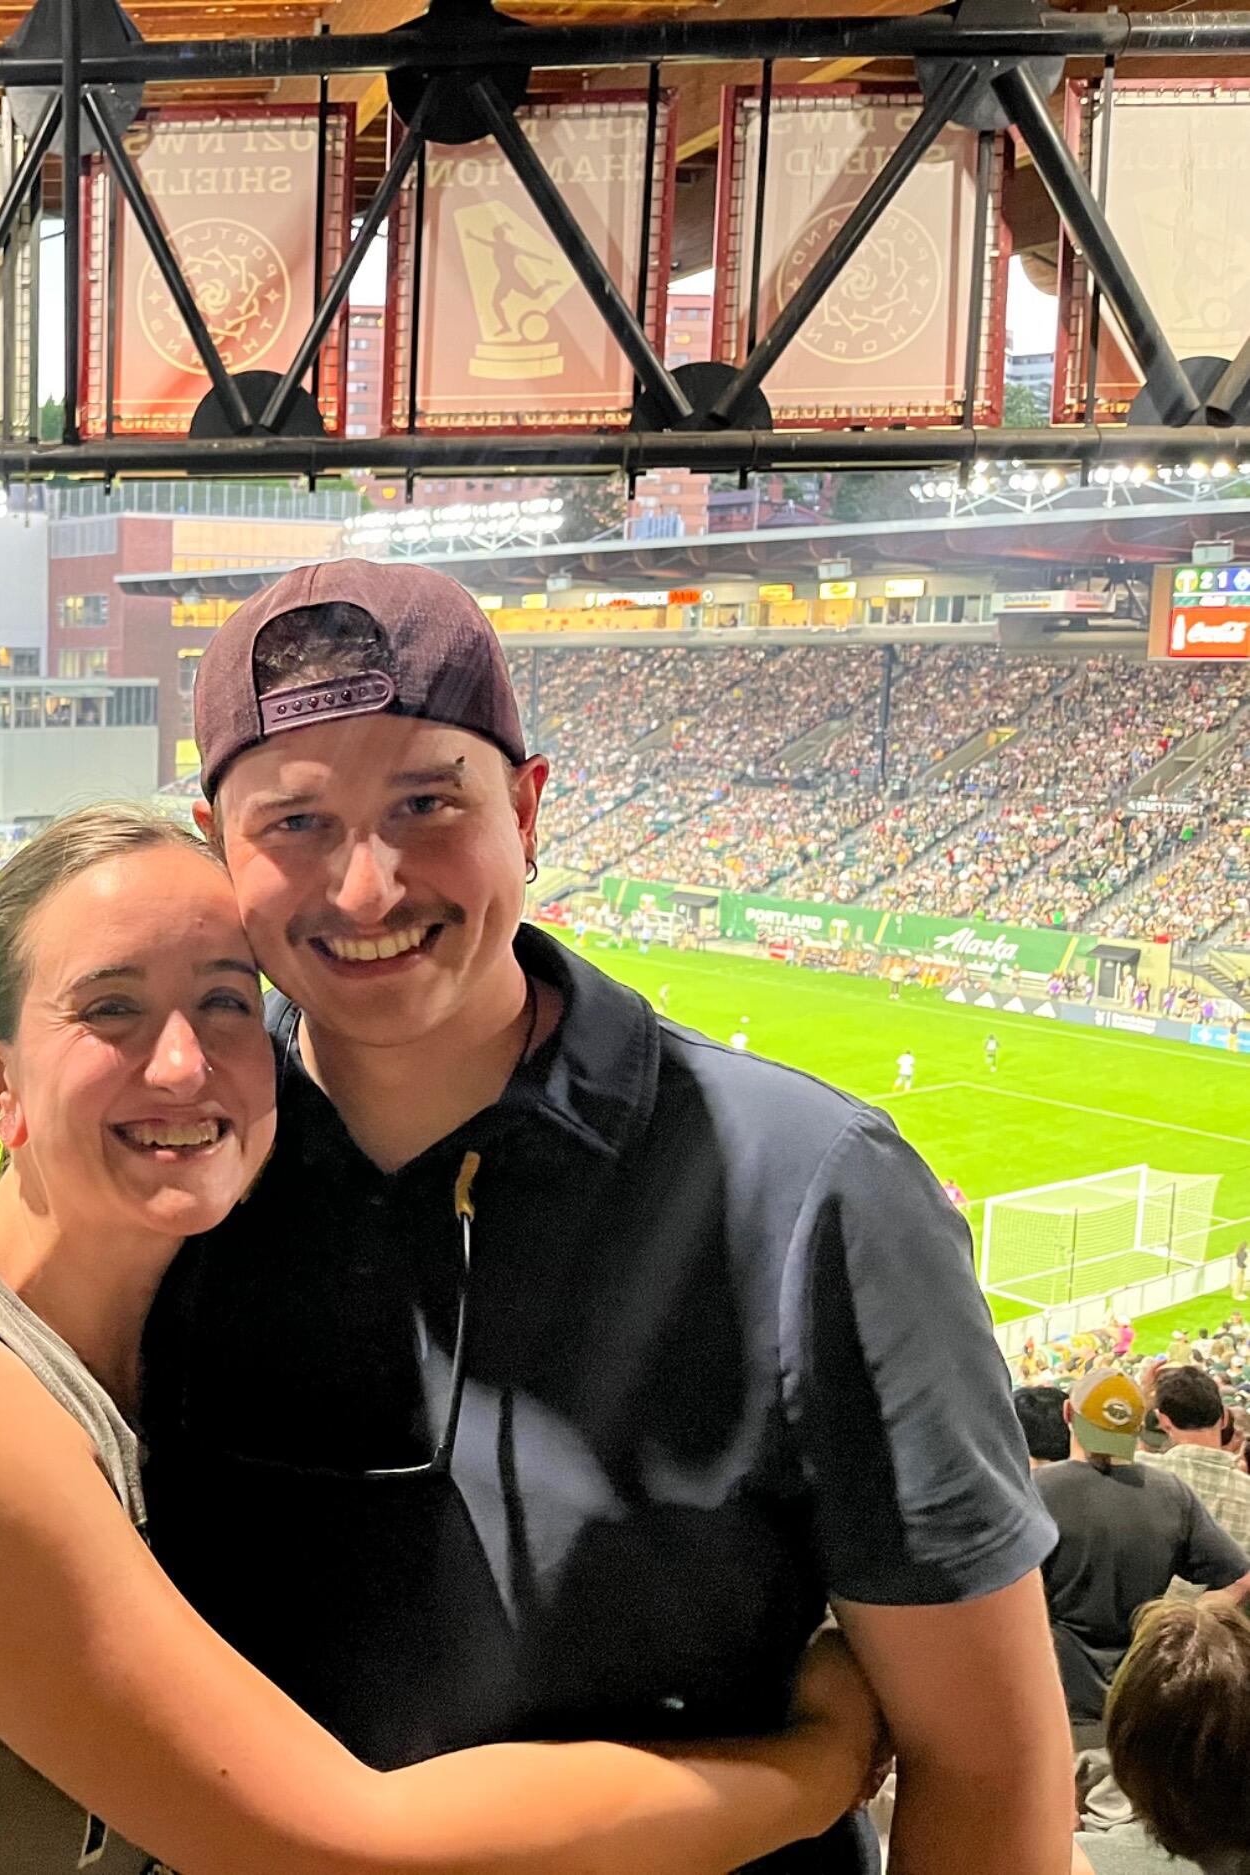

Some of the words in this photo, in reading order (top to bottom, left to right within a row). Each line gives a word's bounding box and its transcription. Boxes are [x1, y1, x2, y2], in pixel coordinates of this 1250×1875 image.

[1199, 570, 1214, 590] 2
[745, 908, 823, 932] PORTLAND
[934, 927, 1020, 960] Alaska
